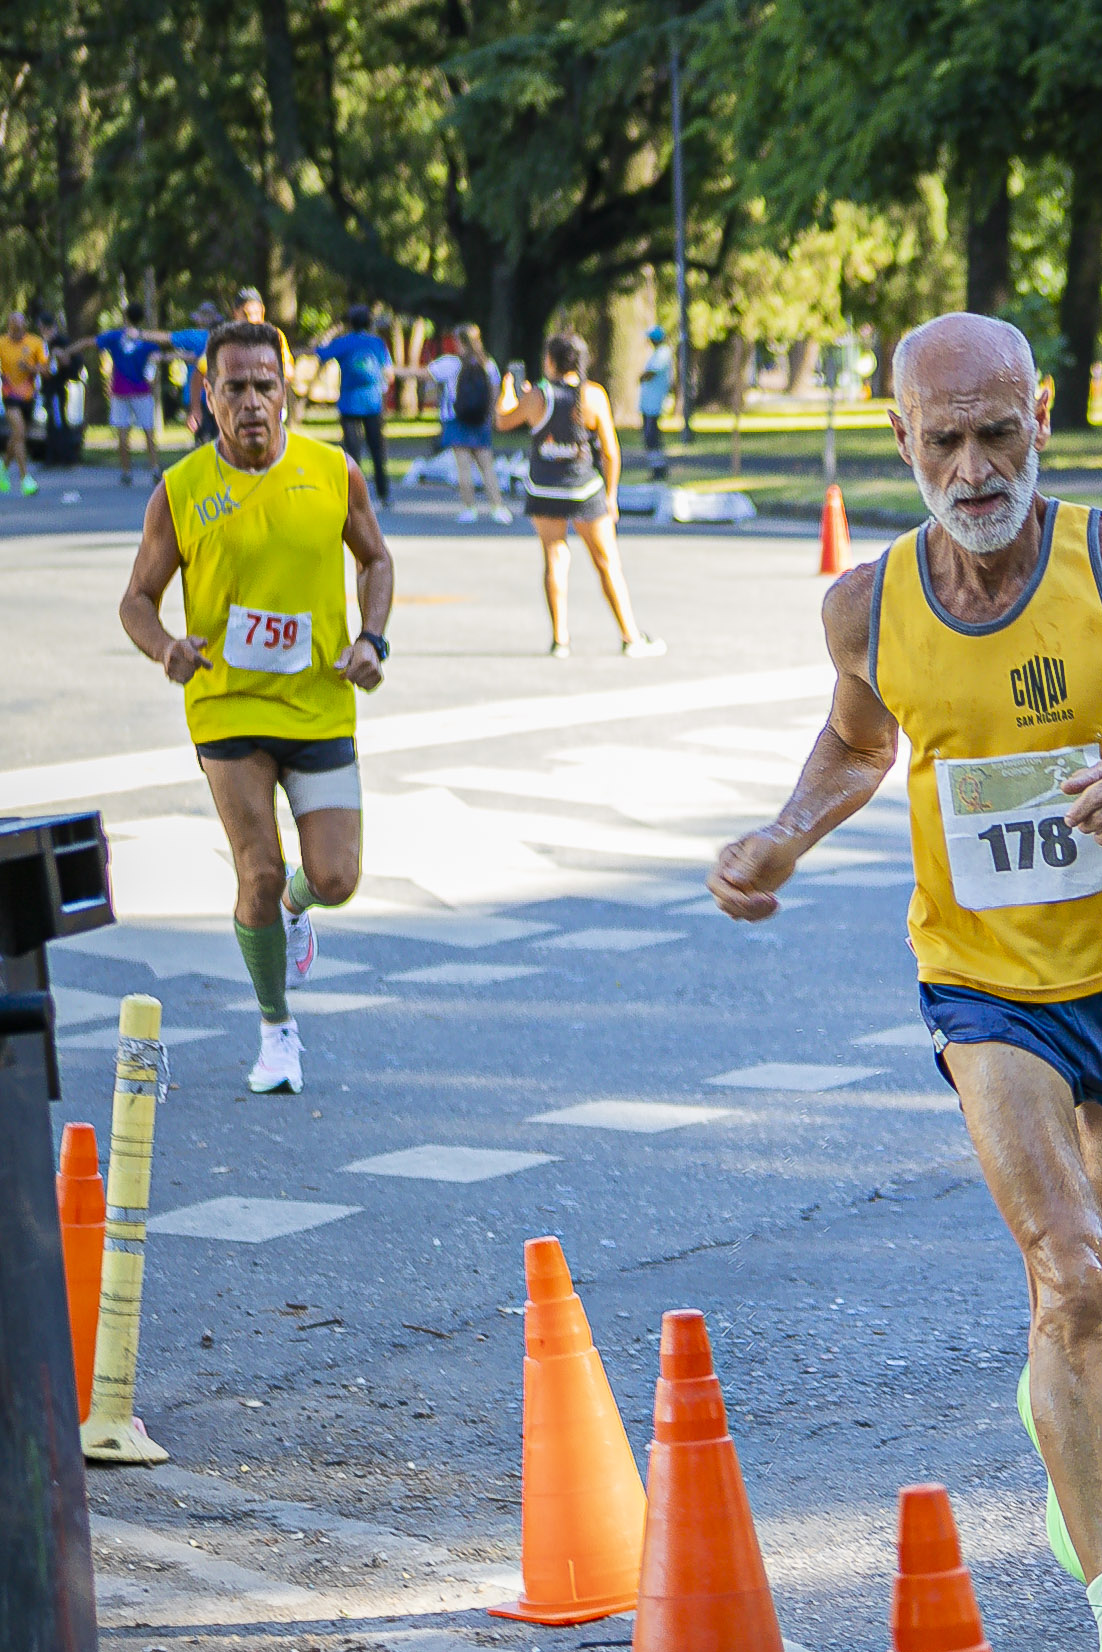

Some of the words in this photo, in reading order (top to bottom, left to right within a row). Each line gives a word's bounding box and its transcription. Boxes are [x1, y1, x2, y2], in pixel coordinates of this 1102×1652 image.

[194, 485, 241, 526] 10K
[245, 613, 298, 651] 759
[1010, 654, 1068, 713] CINAV
[1016, 714, 1035, 728] SAN
[1036, 708, 1074, 725] NICOLAS
[978, 816, 1078, 872] 178
